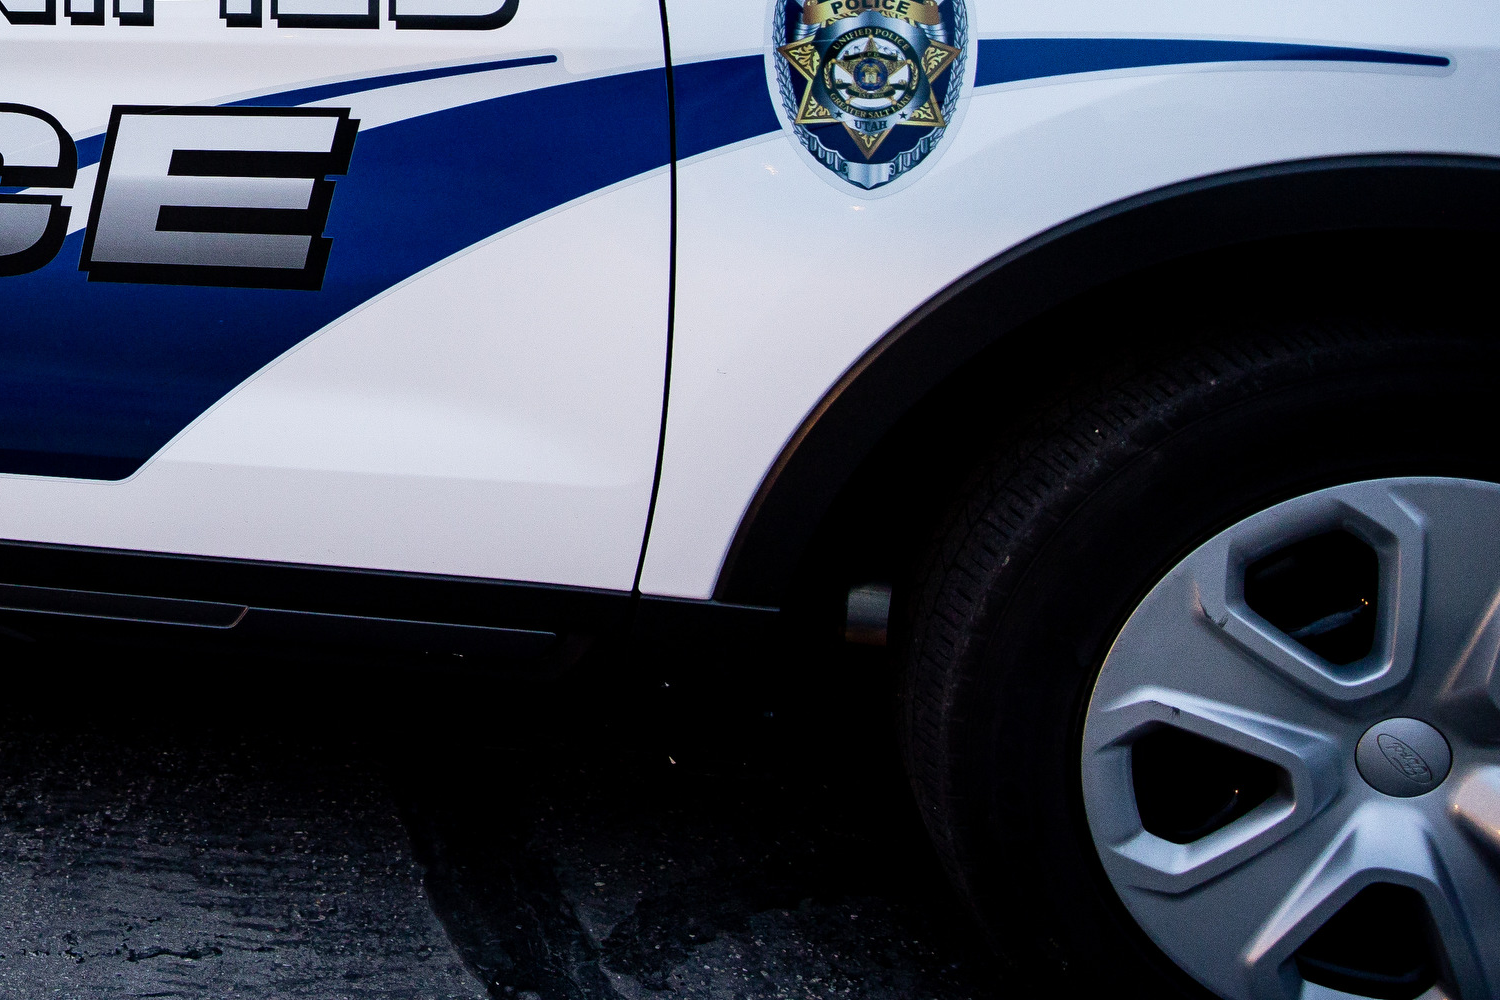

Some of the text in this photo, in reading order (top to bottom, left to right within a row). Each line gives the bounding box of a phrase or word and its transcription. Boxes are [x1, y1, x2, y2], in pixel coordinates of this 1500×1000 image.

[832, 27, 911, 51] UNIFIED POLICE
[830, 93, 912, 119] GREATER SALT LAKE
[854, 120, 888, 132] UTAH
